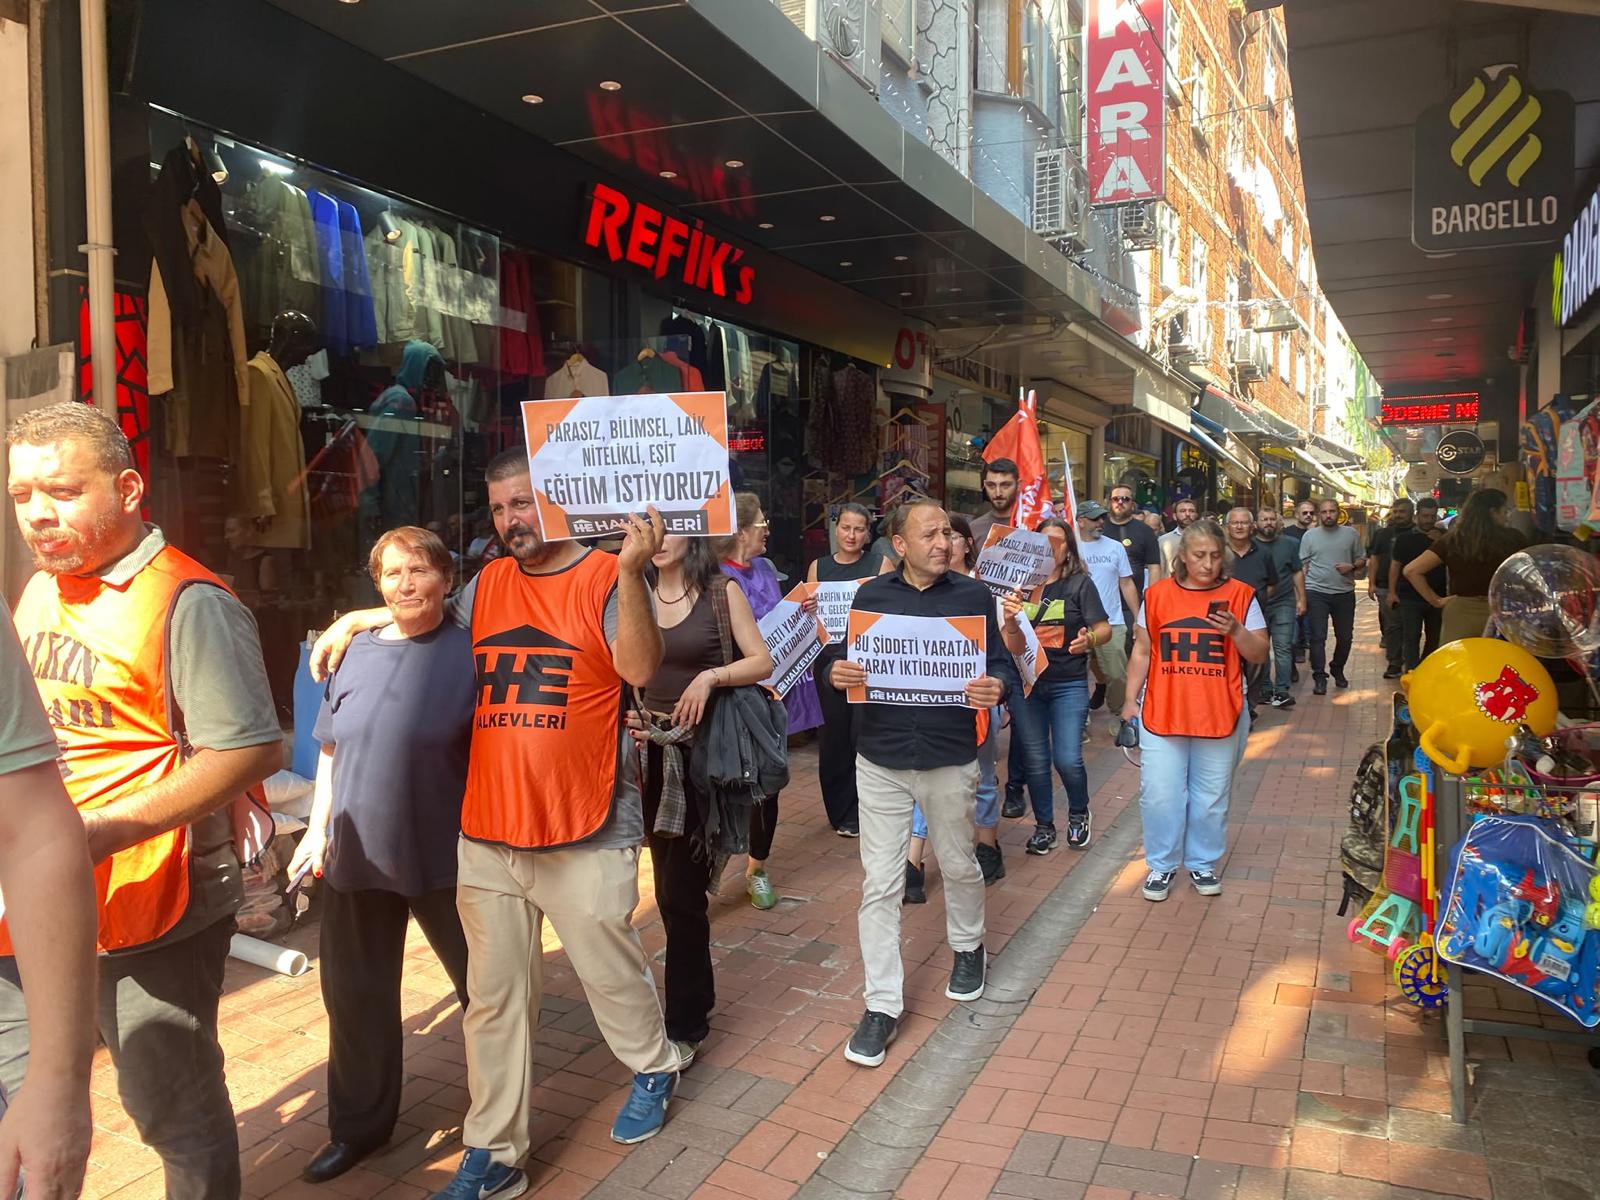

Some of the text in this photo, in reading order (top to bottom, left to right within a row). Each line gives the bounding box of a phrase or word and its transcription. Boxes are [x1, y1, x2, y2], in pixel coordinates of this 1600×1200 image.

[1431, 196, 1557, 235] BARGELLO
[546, 413, 710, 443] PARASIZ, BİLİMSEL, LAİK,
[582, 441, 676, 467] NİTELİKLİ, EŞİT
[543, 469, 722, 505] EĞİTİM İSTİYORUZ!
[978, 559, 1009, 581] EĞİTİM
[855, 634, 980, 657] BU ŞİDDETİ YARATAN
[784, 640, 821, 686] HALKEVLERİ
[899, 657, 977, 679] İKTİDARIDIR!
[886, 691, 966, 703] HALKEVLERİ
[47, 698, 117, 728] ARI
